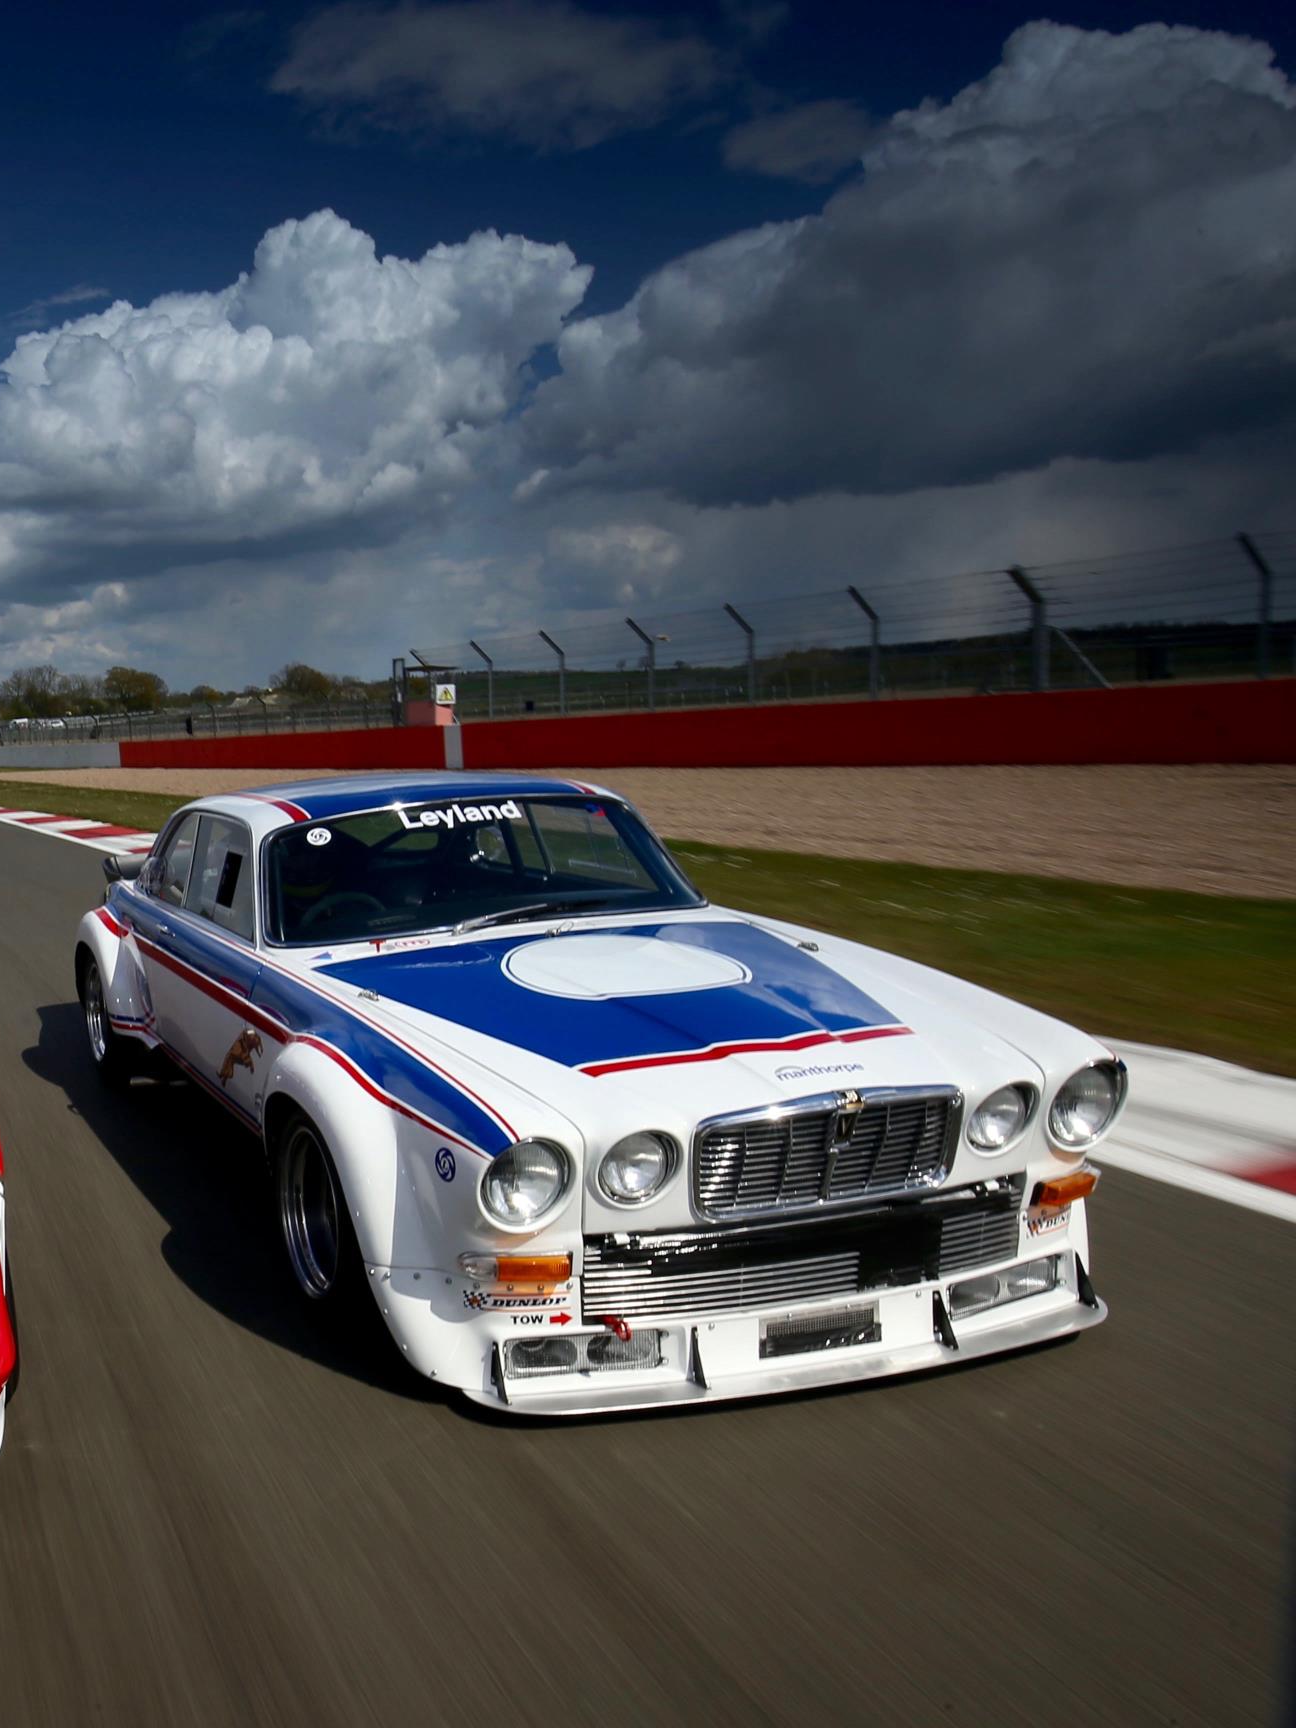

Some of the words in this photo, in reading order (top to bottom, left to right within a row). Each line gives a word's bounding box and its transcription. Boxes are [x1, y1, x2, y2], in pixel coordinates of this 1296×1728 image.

[397, 800, 522, 829] Leyland
[775, 1063, 864, 1081] manthorpe
[491, 1296, 566, 1308] DUNLOP
[510, 1314, 544, 1325] TOW
